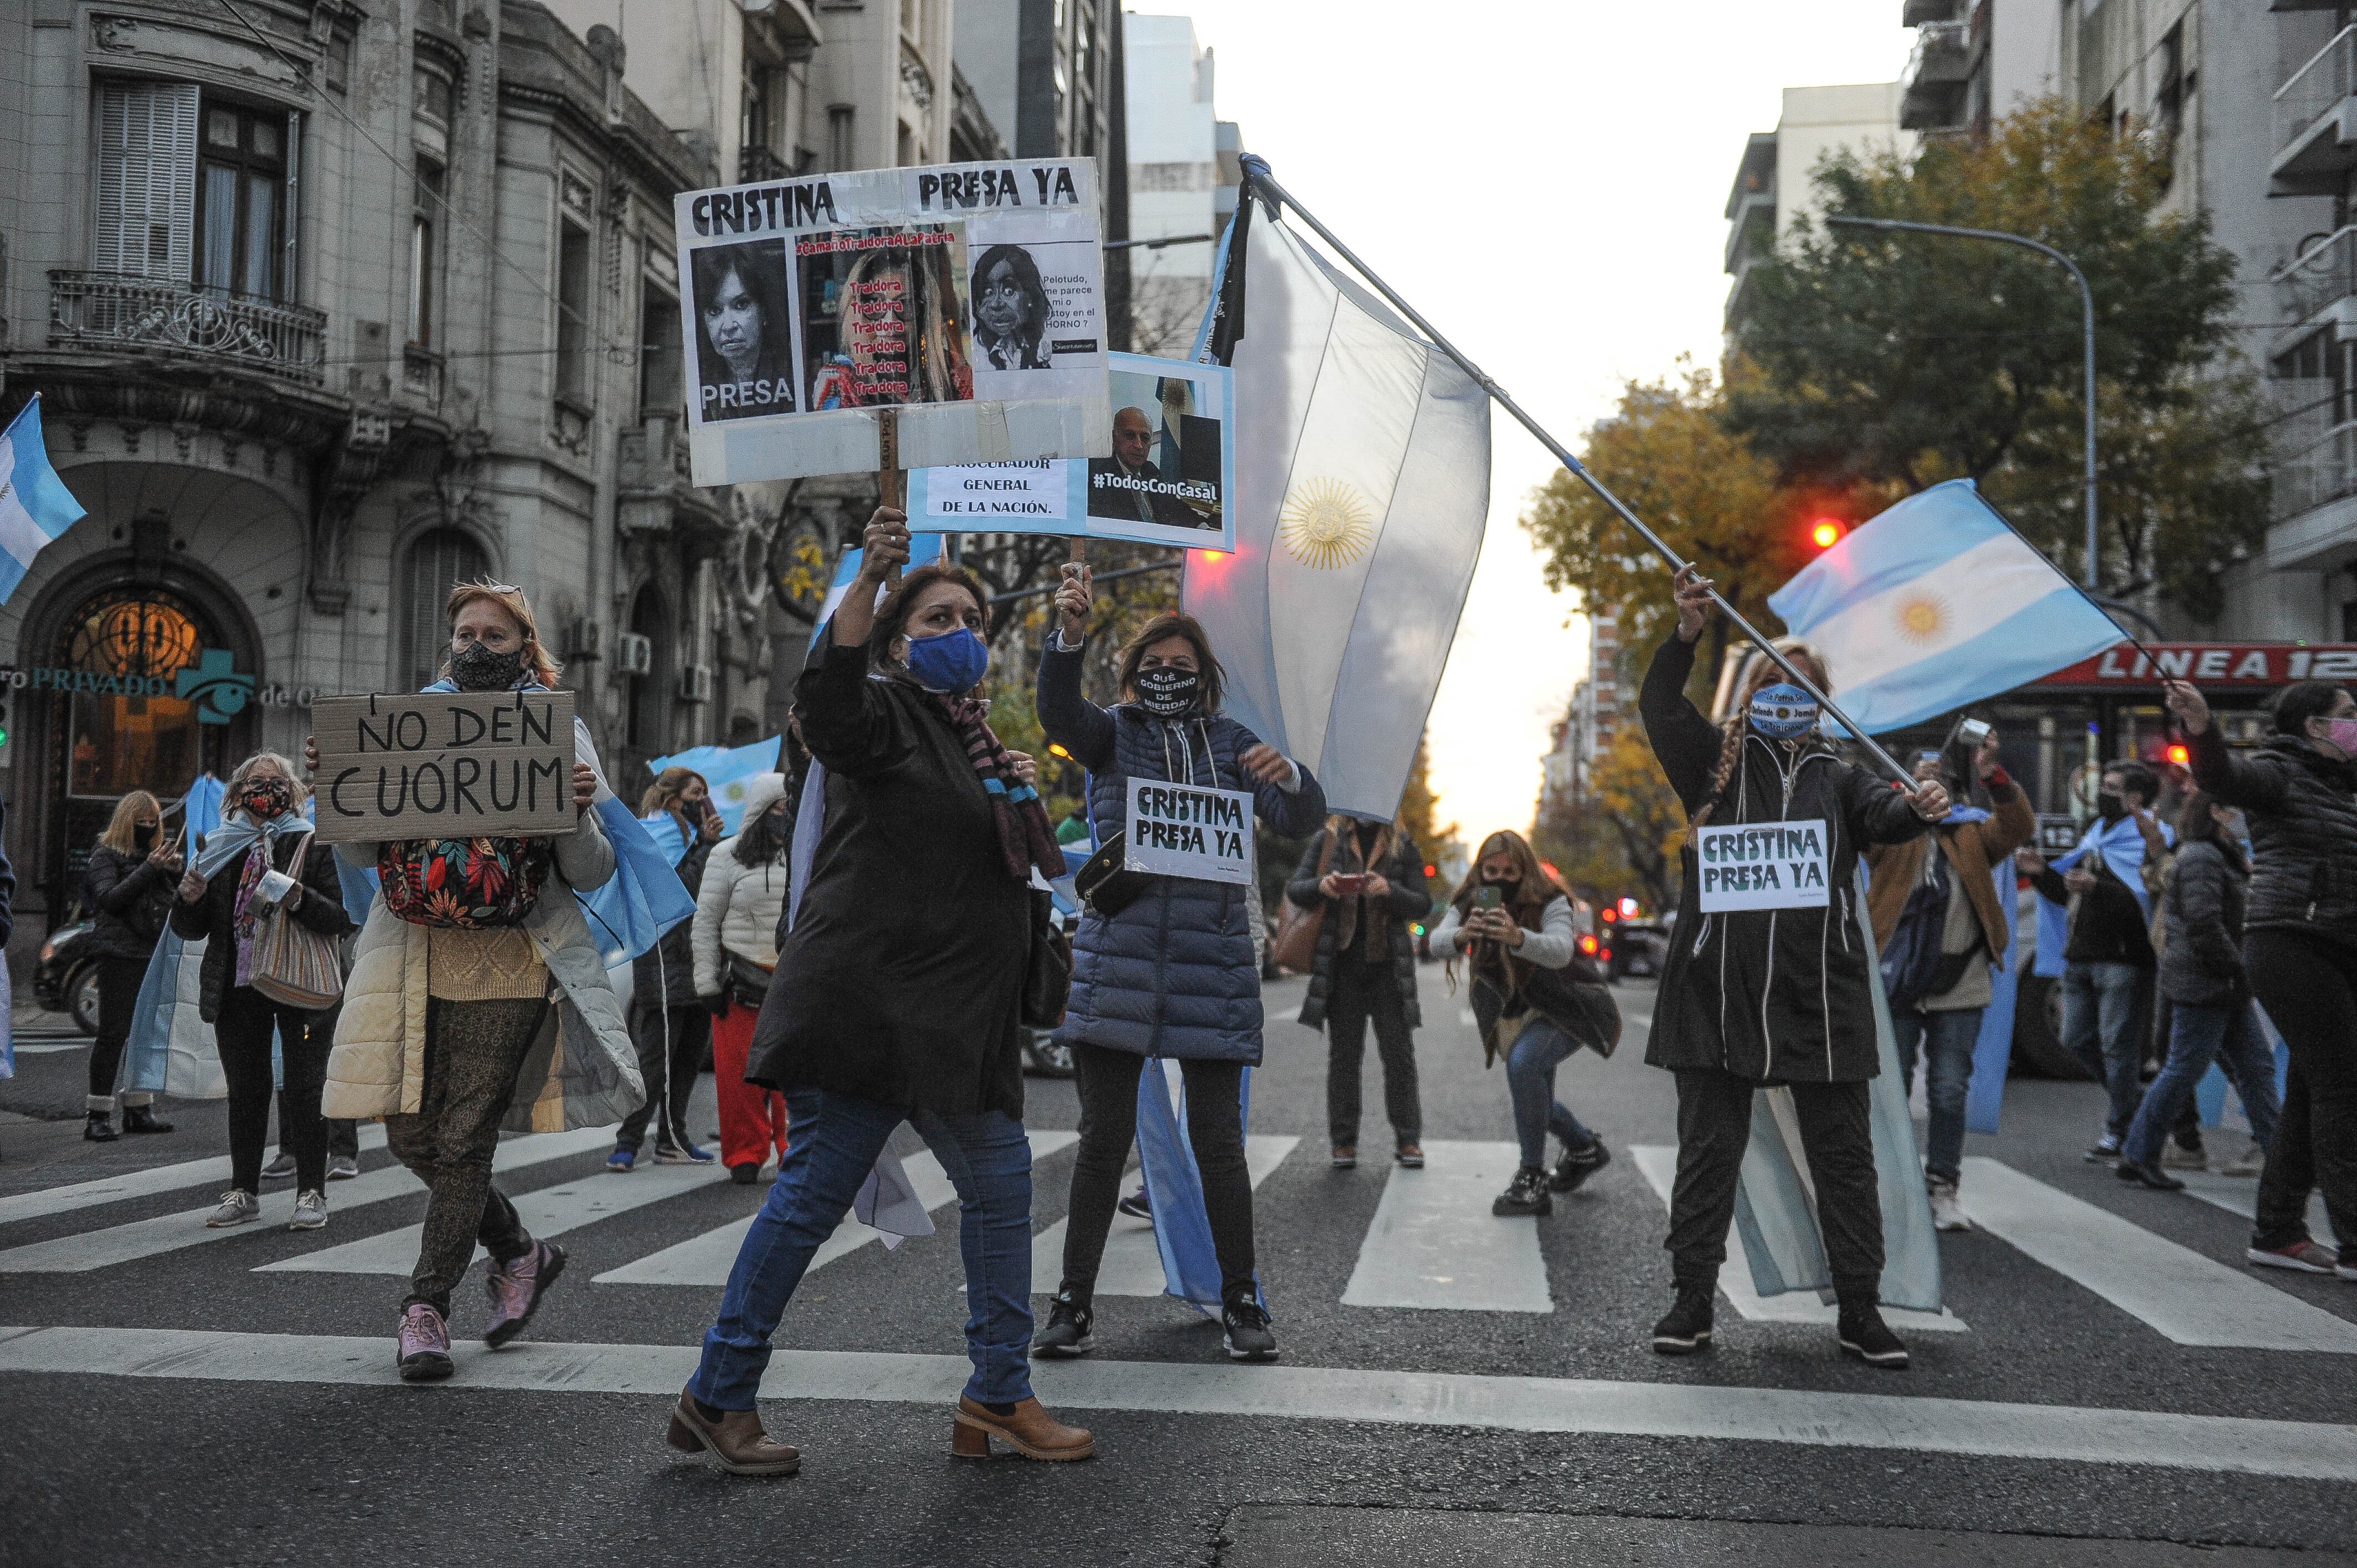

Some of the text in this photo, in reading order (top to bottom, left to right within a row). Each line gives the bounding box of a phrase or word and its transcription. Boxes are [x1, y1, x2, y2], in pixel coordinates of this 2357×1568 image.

[692, 167, 1079, 236] CRISTINA PRESA YA
[850, 279, 902, 294] Traidora
[1043, 275, 1087, 284] Pelotudo,
[1061, 287, 1092, 295] parece
[851, 300, 903, 315] Traidora
[852, 319, 904, 335] Traidora
[1046, 319, 1080, 328] HORNO
[853, 339, 905, 355] Traidora
[855, 359, 907, 375] Traidora
[701, 378, 793, 409] PRESA
[855, 380, 908, 395] Traidora
[945, 458, 1051, 470] URADOR
[964, 479, 1032, 491] GENERAL
[1093, 473, 1217, 501] #TodosConCasal
[943, 500, 1052, 514] DE LA NACIÓN.
[2098, 649, 2268, 679] LINEA
[1140, 677, 1196, 692] GOBIERNO
[1153, 672, 1176, 683] QUÉ
[33, 668, 166, 698] PRIVADO
[259, 683, 289, 708] de
[358, 703, 553, 752] NO DEN
[331, 754, 564, 817] CUÓRUM
[1137, 786, 1244, 829] CRISTINA
[1136, 819, 1244, 860] PRESA YA
[1703, 828, 1823, 863] CRISTINA
[1704, 862, 1825, 894] PRESA YA
